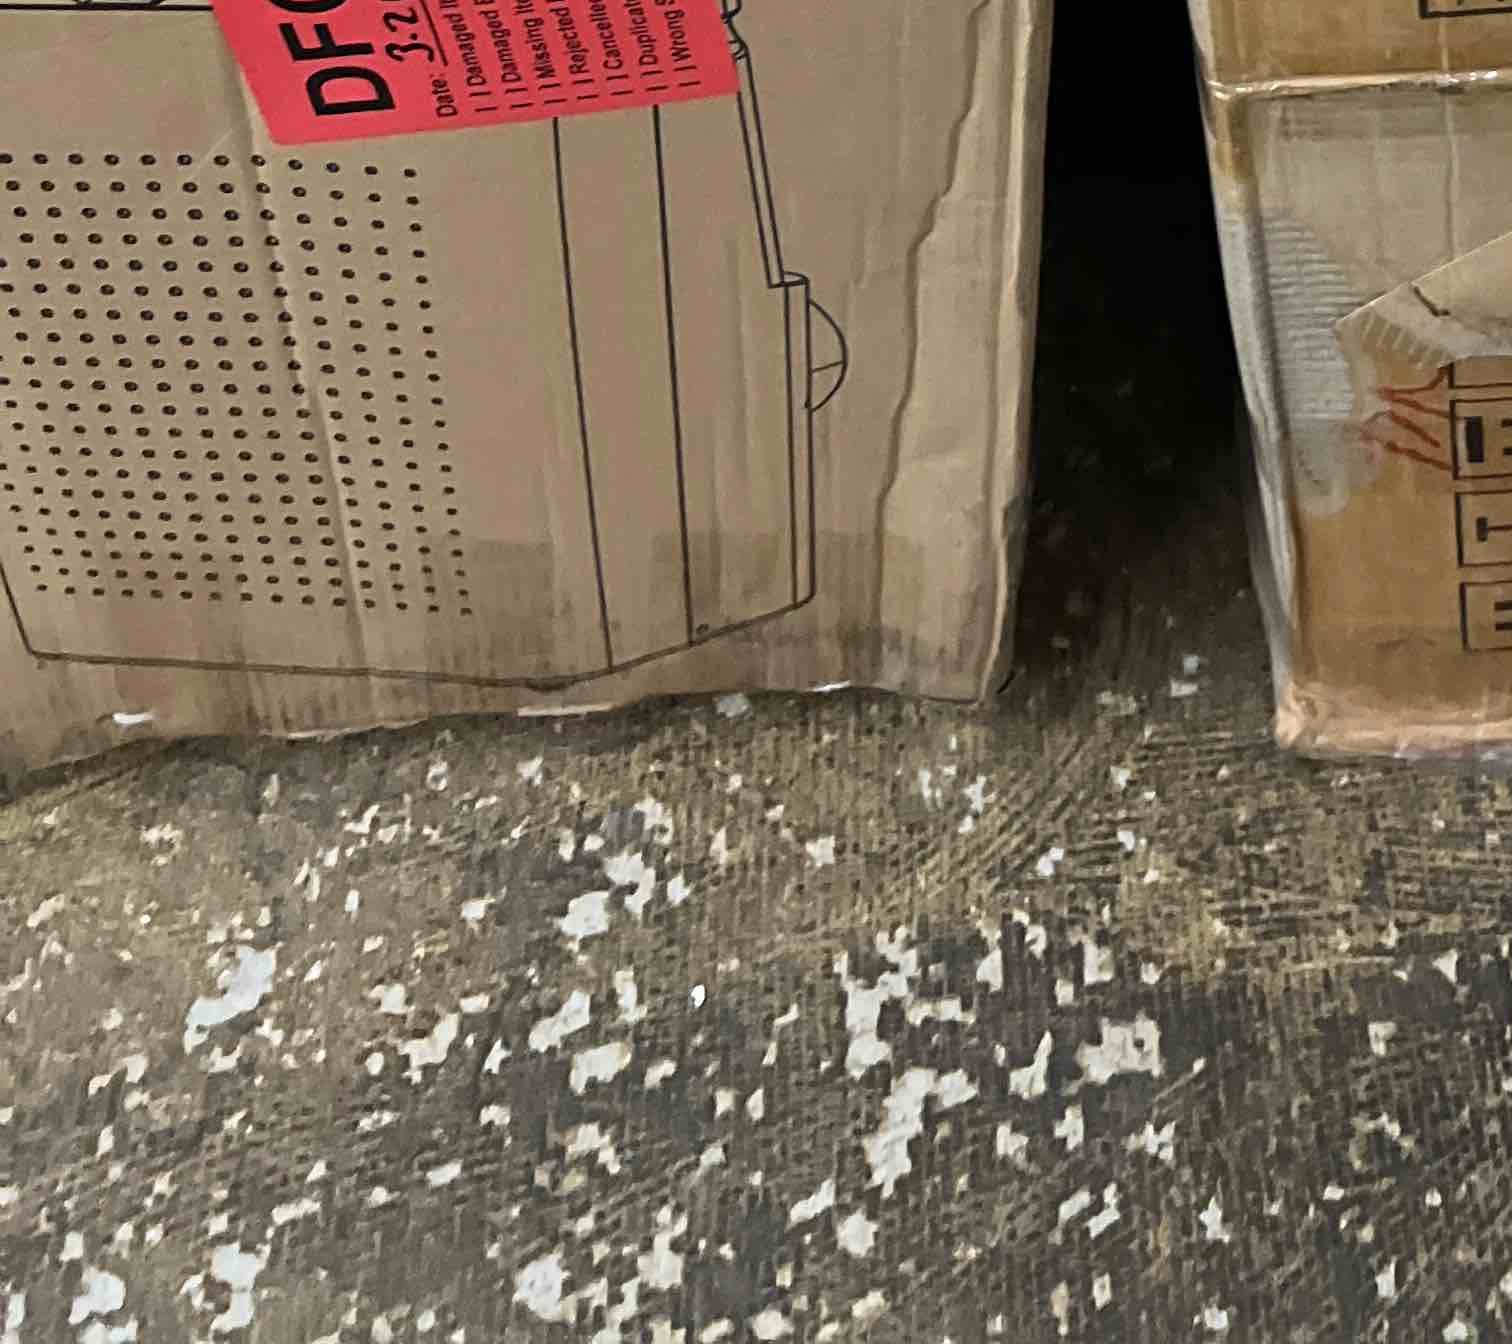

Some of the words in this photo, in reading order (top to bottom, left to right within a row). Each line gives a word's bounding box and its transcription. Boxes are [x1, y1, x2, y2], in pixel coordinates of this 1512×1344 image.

[449, 12, 487, 87] Damaged
[480, 10, 522, 83] Damaged
[523, 16, 557, 81] Missing
[555, 6, 588, 76] Rejected
[663, 7, 691, 63] Wrong
[431, 72, 459, 118] Date:
